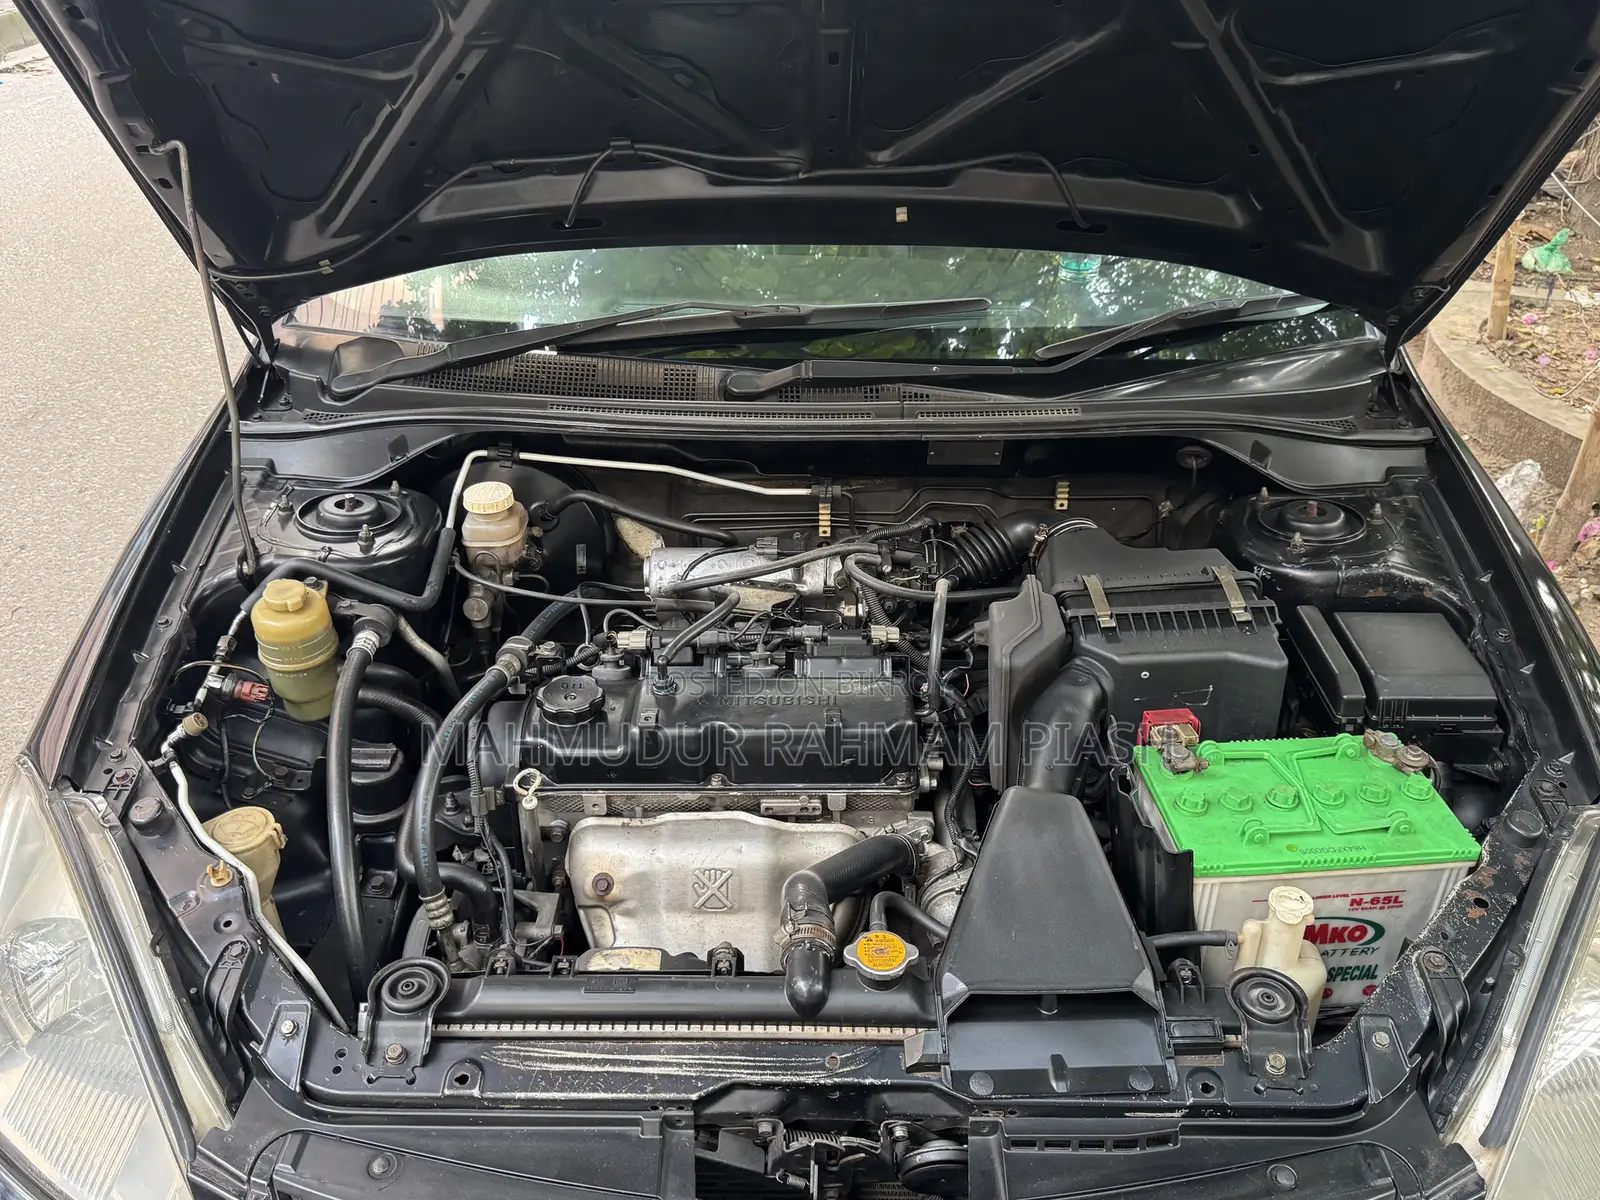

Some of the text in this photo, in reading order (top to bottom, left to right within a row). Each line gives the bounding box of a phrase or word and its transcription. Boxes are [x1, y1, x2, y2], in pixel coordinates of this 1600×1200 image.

[561, 682, 585, 690] OIL
[719, 695, 838, 706] MITSUBISHI
[1349, 895, 1404, 907] N-65L
[1303, 923, 1368, 945] MKO
[1320, 947, 1380, 958] ATTERY
[1326, 964, 1379, 983] SPECIAL
